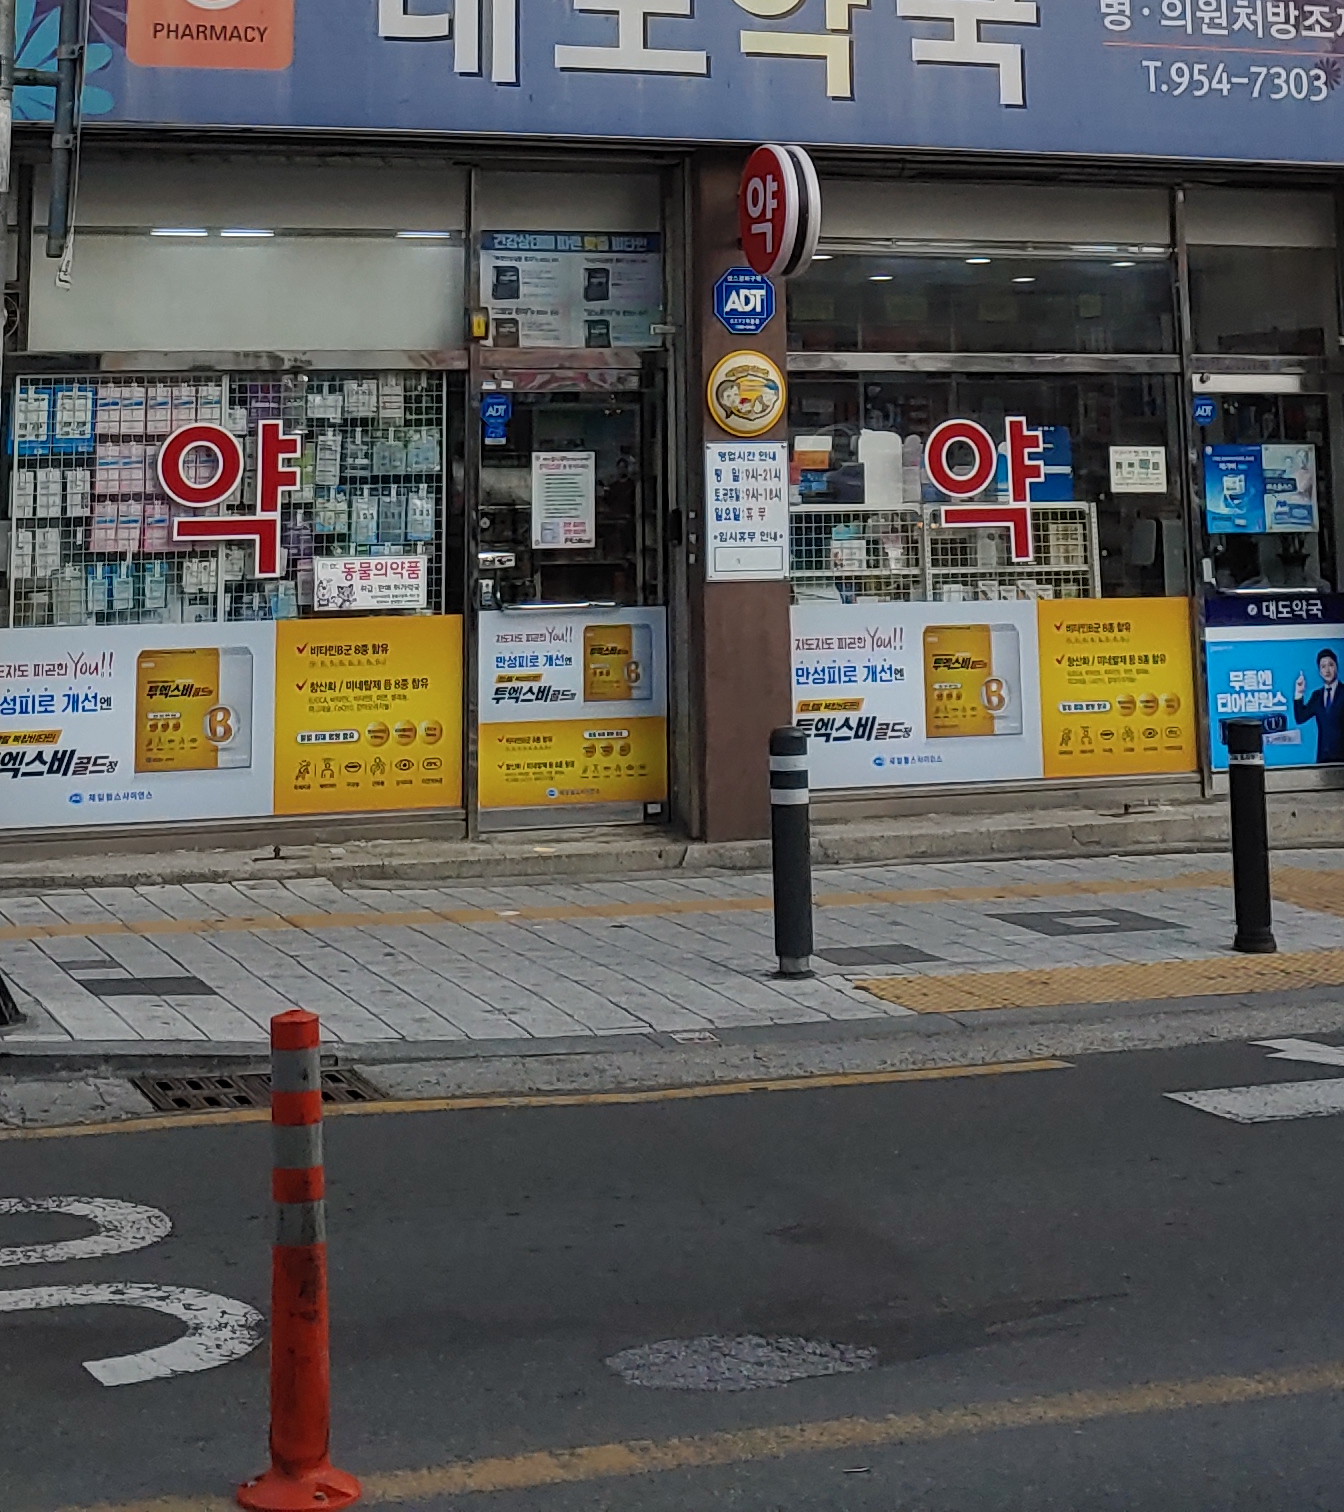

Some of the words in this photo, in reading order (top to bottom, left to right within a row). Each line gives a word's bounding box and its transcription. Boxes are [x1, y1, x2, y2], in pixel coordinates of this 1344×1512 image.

[152, 21, 269, 45] PHARMACY
[1141, 59, 1329, 101] T.954-7303
[745, 174, 779, 254] 약
[724, 288, 767, 313] ADT
[485, 404, 507, 418] ADT
[717, 450, 756, 463] 영업시간
[758, 450, 777, 462] 안내
[157, 420, 302, 578] 약
[925, 416, 1044, 562] 약
[759, 530, 778, 543] 안내
[341, 560, 422, 582] 동물의약품
[1261, 599, 1323, 620] 대도약국
[33, 662, 69, 678] 피곤한
[495, 654, 540, 669] 만성피로
[795, 664, 859, 686] 만성피로
[862, 663, 905, 683] 개선엔
[61, 691, 113, 714] 개선엔
